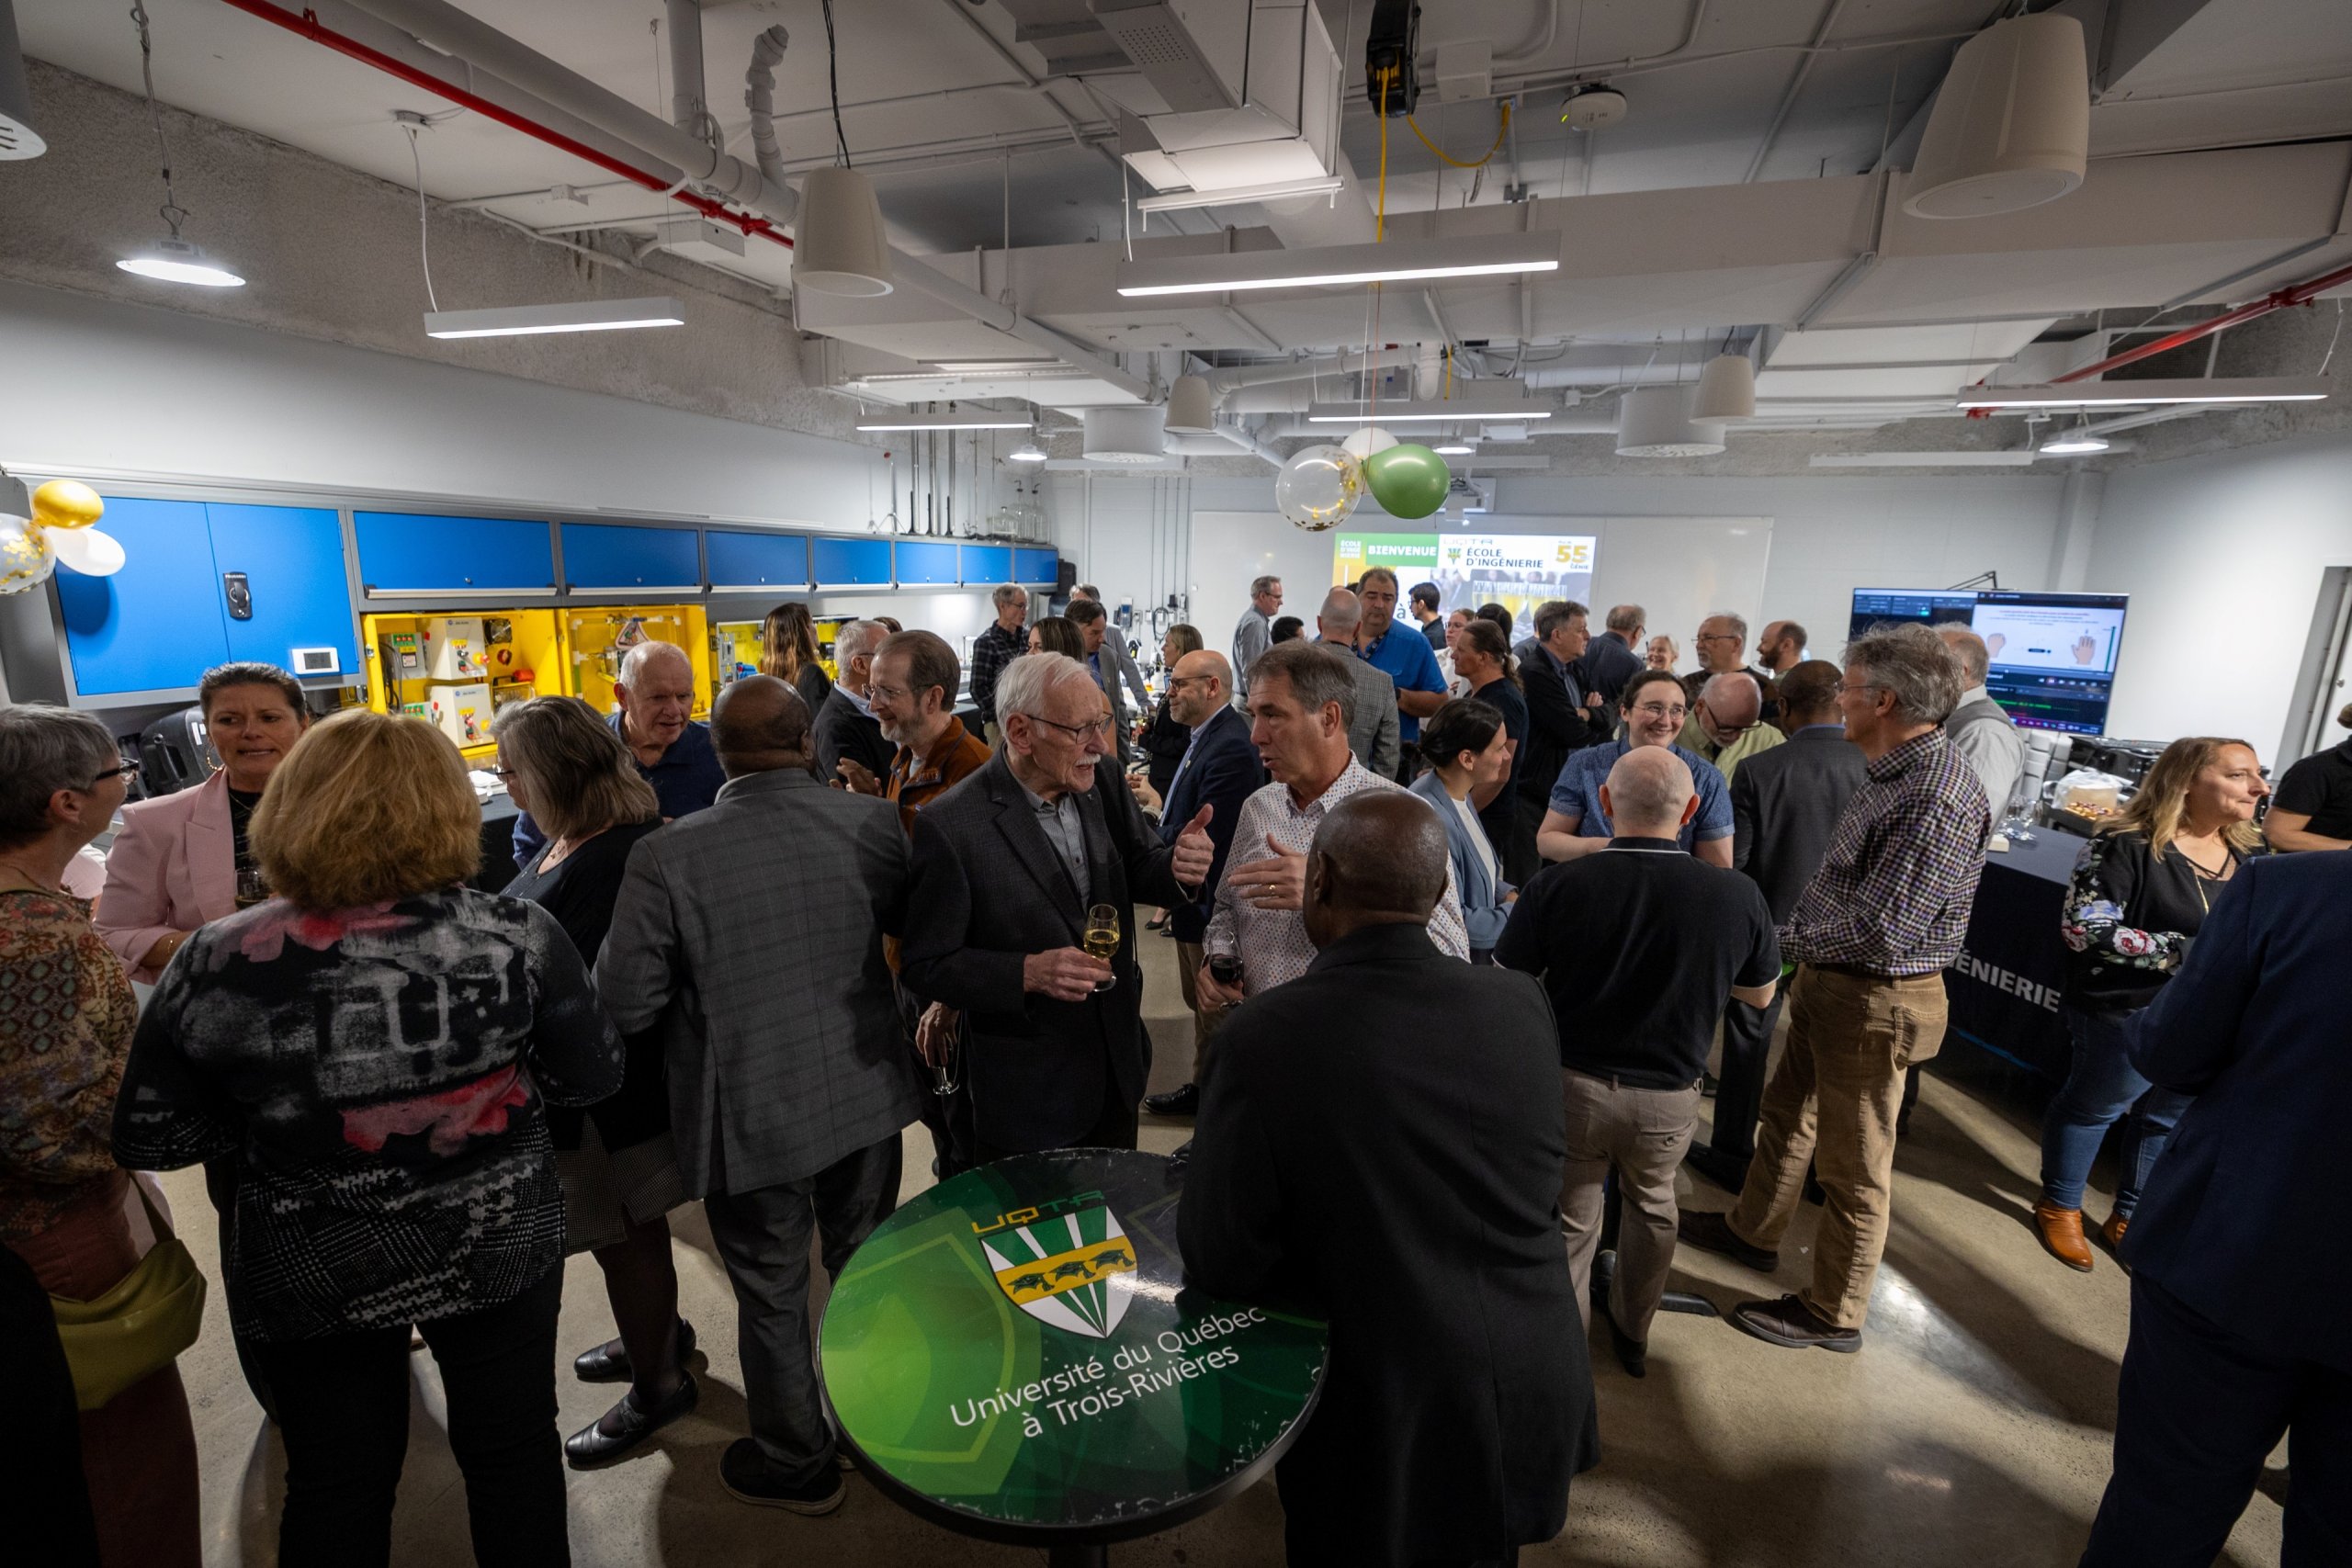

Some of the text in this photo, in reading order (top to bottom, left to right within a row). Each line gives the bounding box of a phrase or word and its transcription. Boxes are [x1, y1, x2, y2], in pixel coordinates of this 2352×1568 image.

[1368, 545, 1437, 557] BIENVENUE
[1466, 547, 1502, 558] ÉCOLE
[1555, 545, 1589, 563] 55
[1465, 558, 1544, 569] D'INGÉNIERIE
[1396, 603, 1406, 619] à
[971, 1190, 1105, 1234] UQTR
[950, 1306, 1266, 1427] Université du Québec
[1021, 1345, 1239, 1438] à Trois-Rivières
